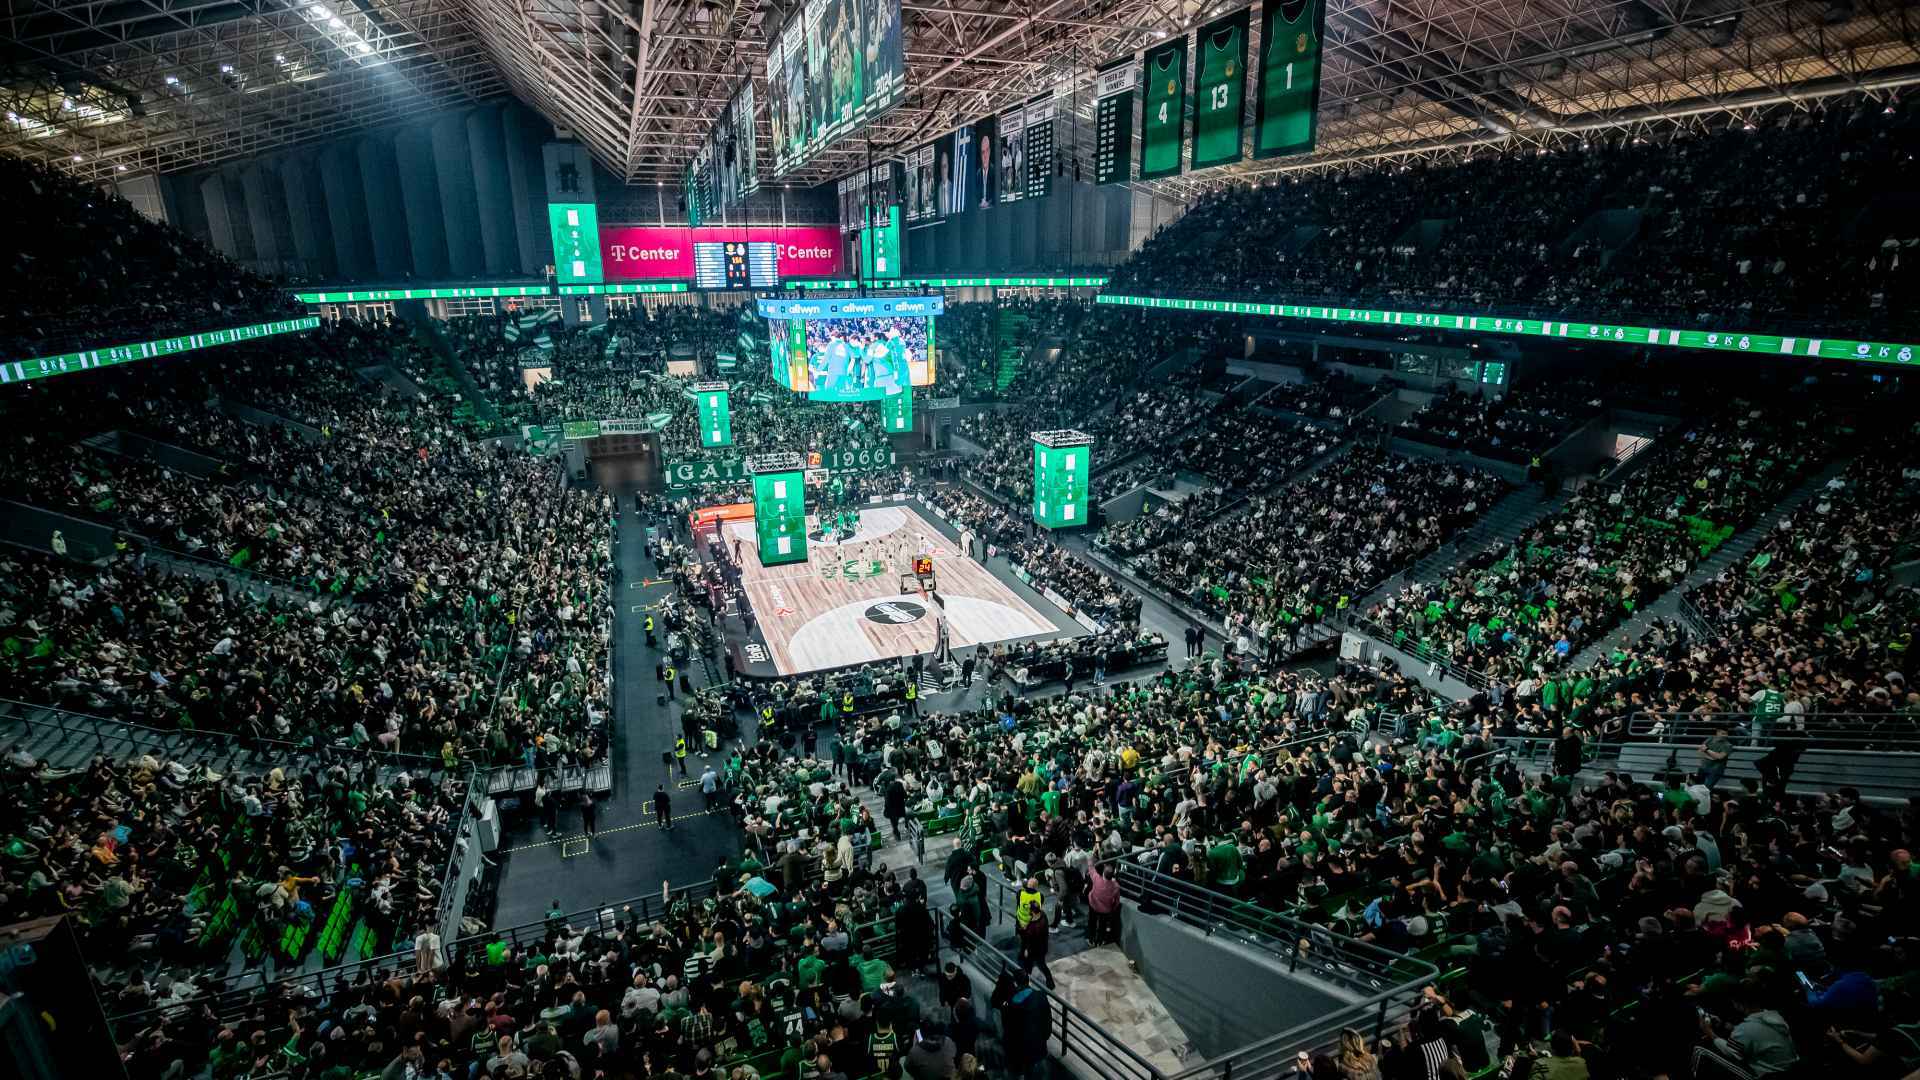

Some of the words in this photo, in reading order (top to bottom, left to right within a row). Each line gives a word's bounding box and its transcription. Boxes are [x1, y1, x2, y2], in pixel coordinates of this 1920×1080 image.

[1285, 62, 1293, 90] 1
[1211, 83, 1229, 110] 13
[1158, 102, 1168, 124] 4
[628, 245, 680, 261] Center
[787, 245, 833, 260] Center
[789, 304, 820, 315] allwyn
[842, 302, 874, 313] allwyn
[895, 302, 925, 313] allwyn
[832, 449, 885, 468] 1966
[918, 564, 930, 573] 24
[1765, 703, 1781, 713] 25
